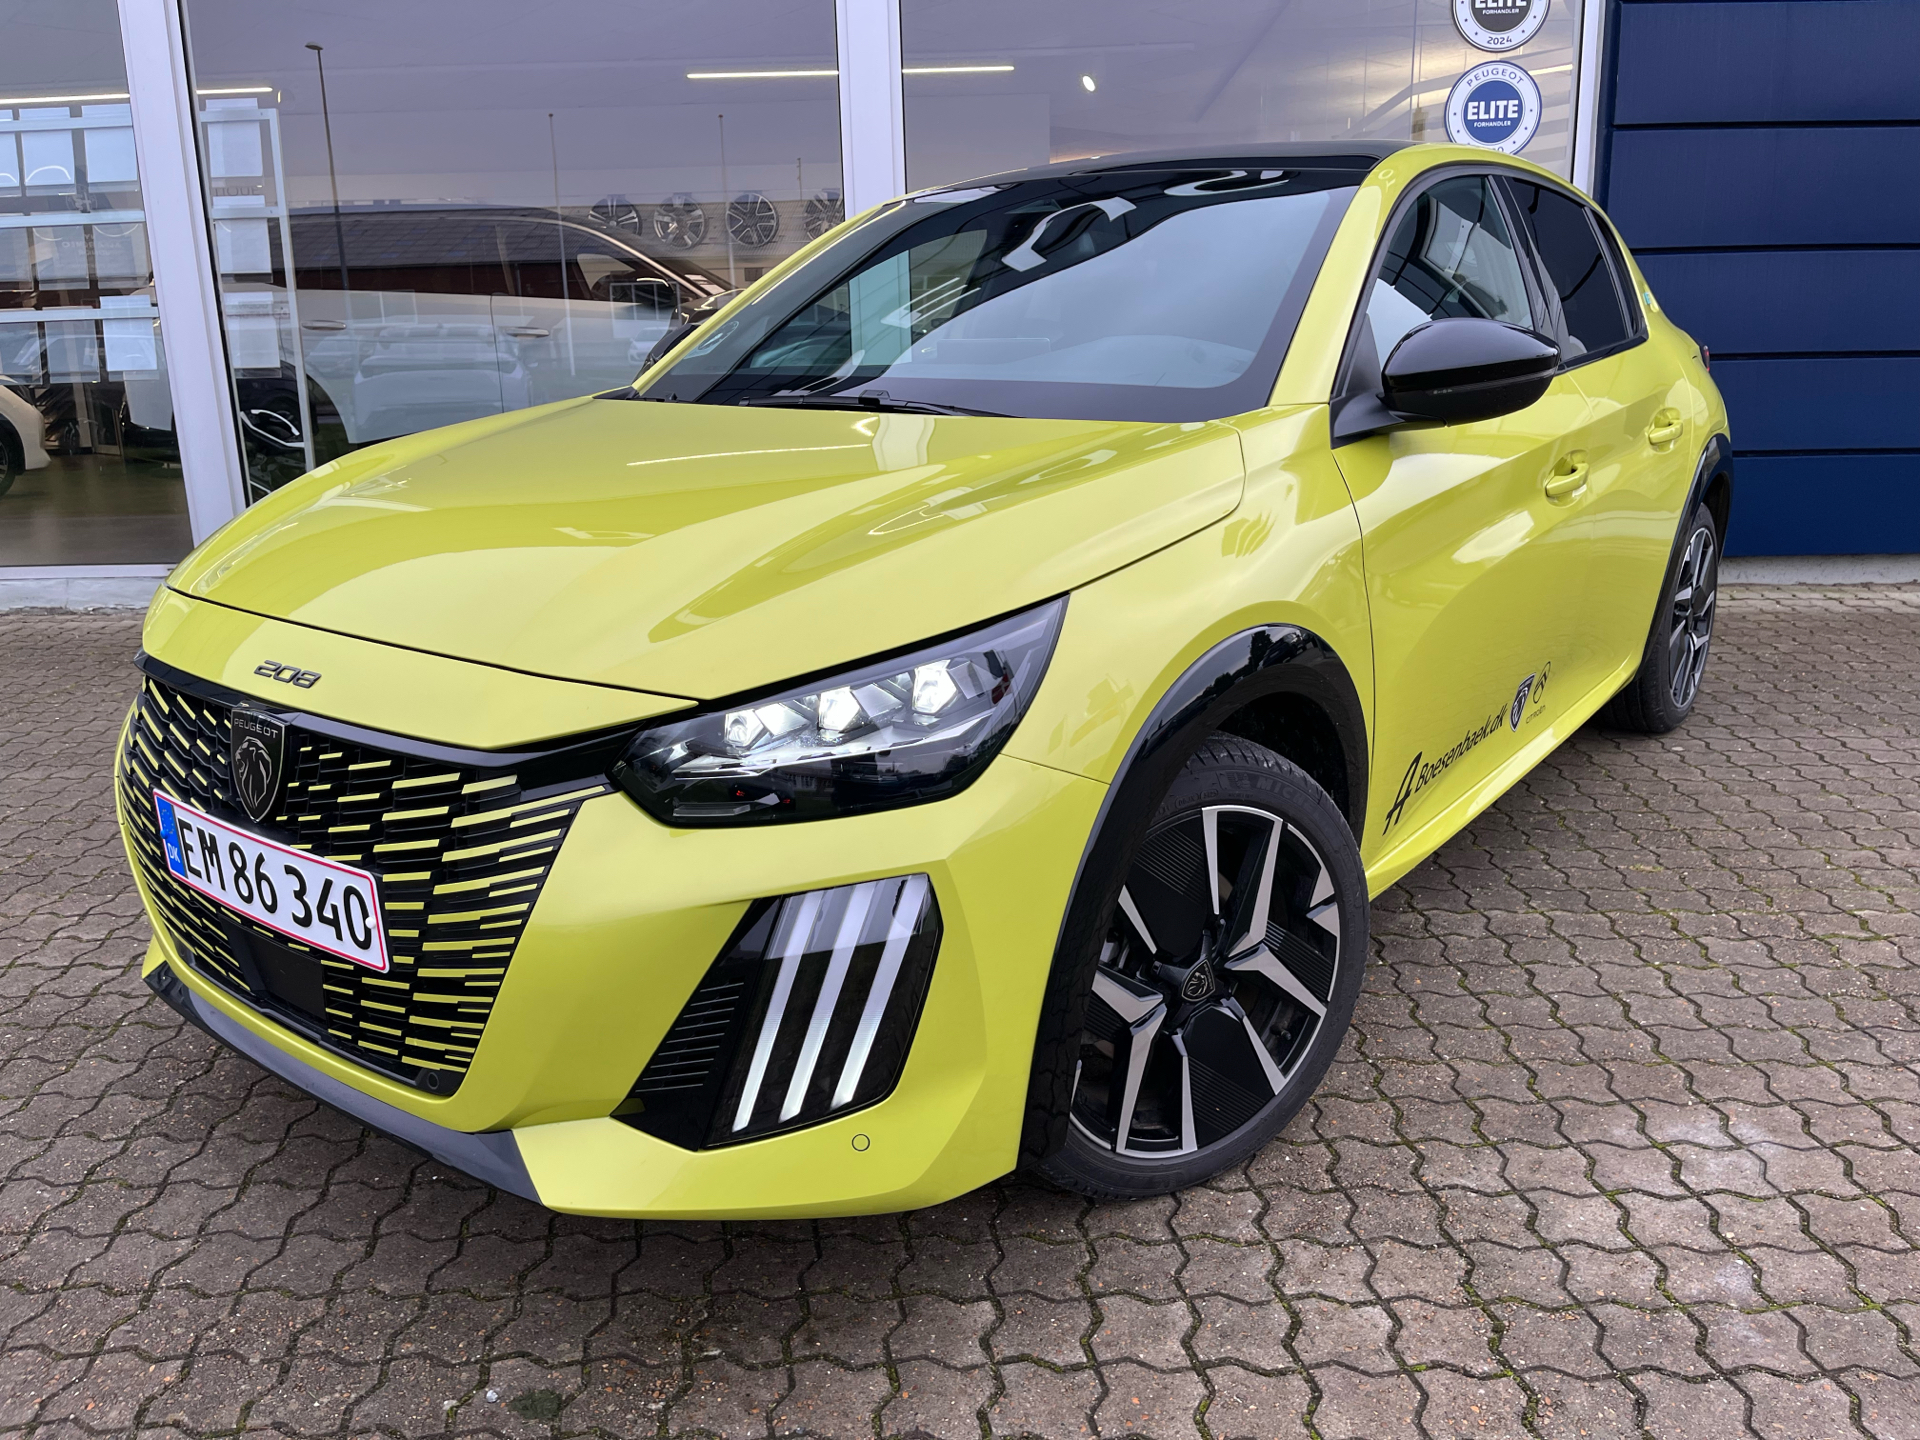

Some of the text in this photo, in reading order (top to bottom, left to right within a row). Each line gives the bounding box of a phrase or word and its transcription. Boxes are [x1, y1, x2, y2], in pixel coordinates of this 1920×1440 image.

[1486, 36, 1513, 45] 2024
[1466, 67, 1525, 88] PEUGEOT
[1467, 100, 1519, 120] ELITE
[1473, 120, 1512, 128] FORHANDLER
[253, 659, 322, 689] 208
[233, 718, 279, 739] PEUGEOT
[166, 842, 181, 864] DK
[177, 817, 373, 950] EM 86 340
